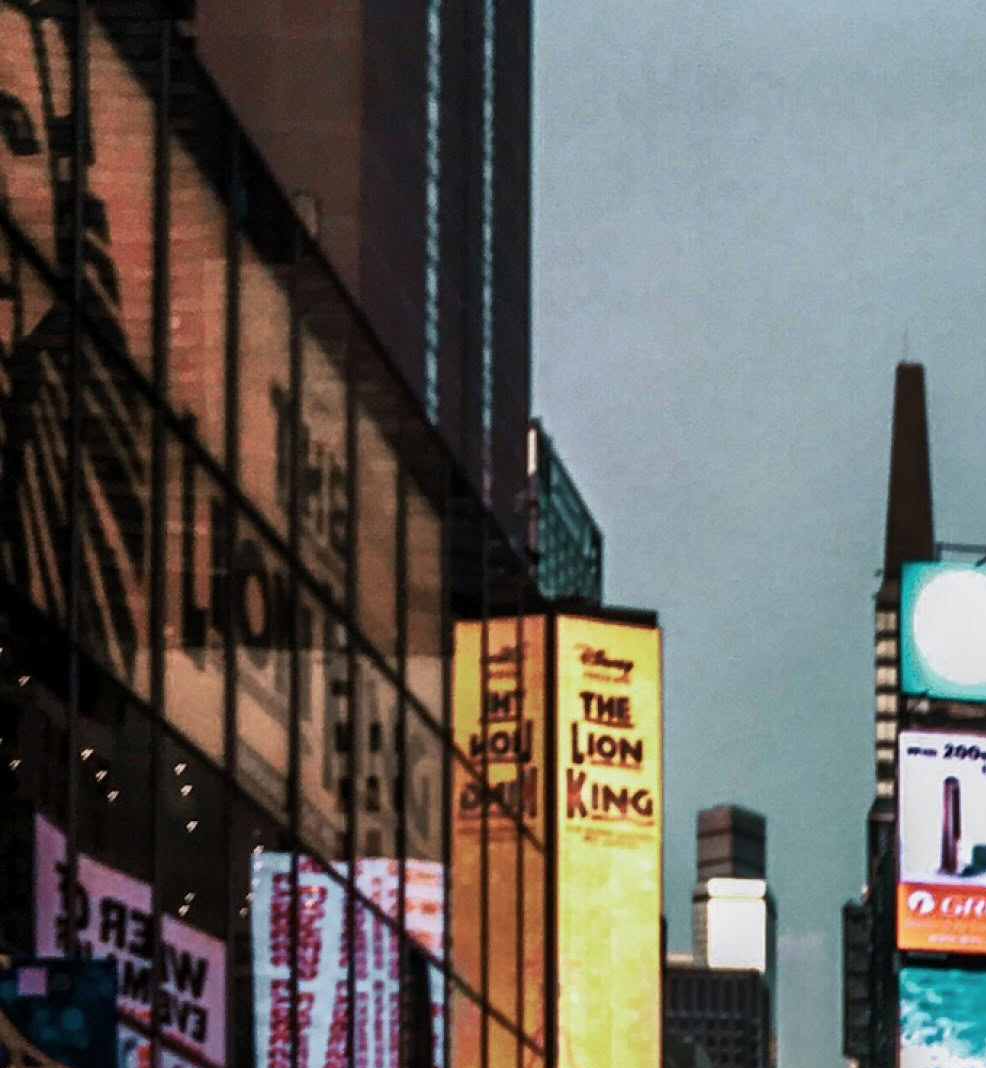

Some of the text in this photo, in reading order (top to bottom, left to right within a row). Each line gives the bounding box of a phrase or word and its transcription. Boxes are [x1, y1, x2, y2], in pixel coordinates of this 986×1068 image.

[579, 691, 632, 727] THE
[570, 721, 644, 766] LION
[566, 767, 654, 819] KING
